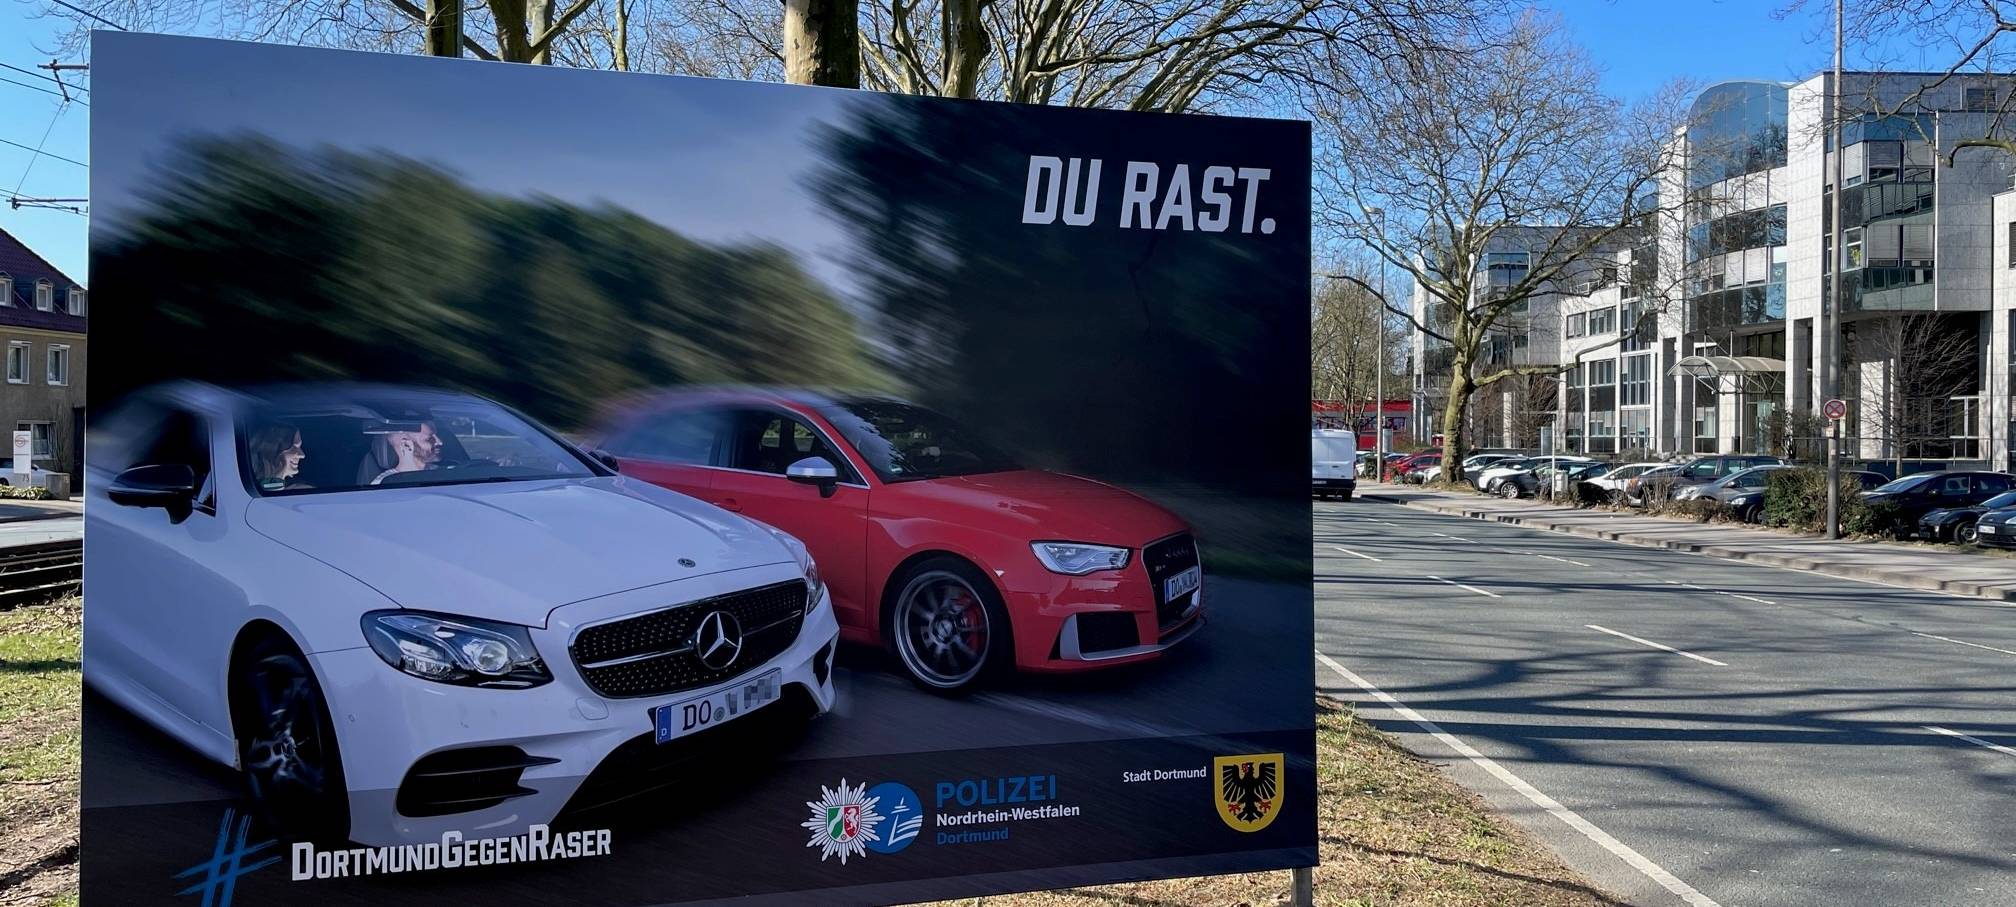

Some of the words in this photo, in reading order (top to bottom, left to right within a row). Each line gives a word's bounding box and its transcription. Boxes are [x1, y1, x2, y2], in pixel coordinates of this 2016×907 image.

[1022, 155, 1102, 226] DU
[1120, 161, 1276, 234] RAST.
[683, 700, 711, 731] DO
[1123, 769, 1151, 782] Stadt
[1154, 766, 1206, 780] Dortmund
[936, 775, 1056, 808] POLIZEI
[936, 804, 1080, 826] Nordrhein-Westfalen
[937, 827, 1009, 845] Dortmund
